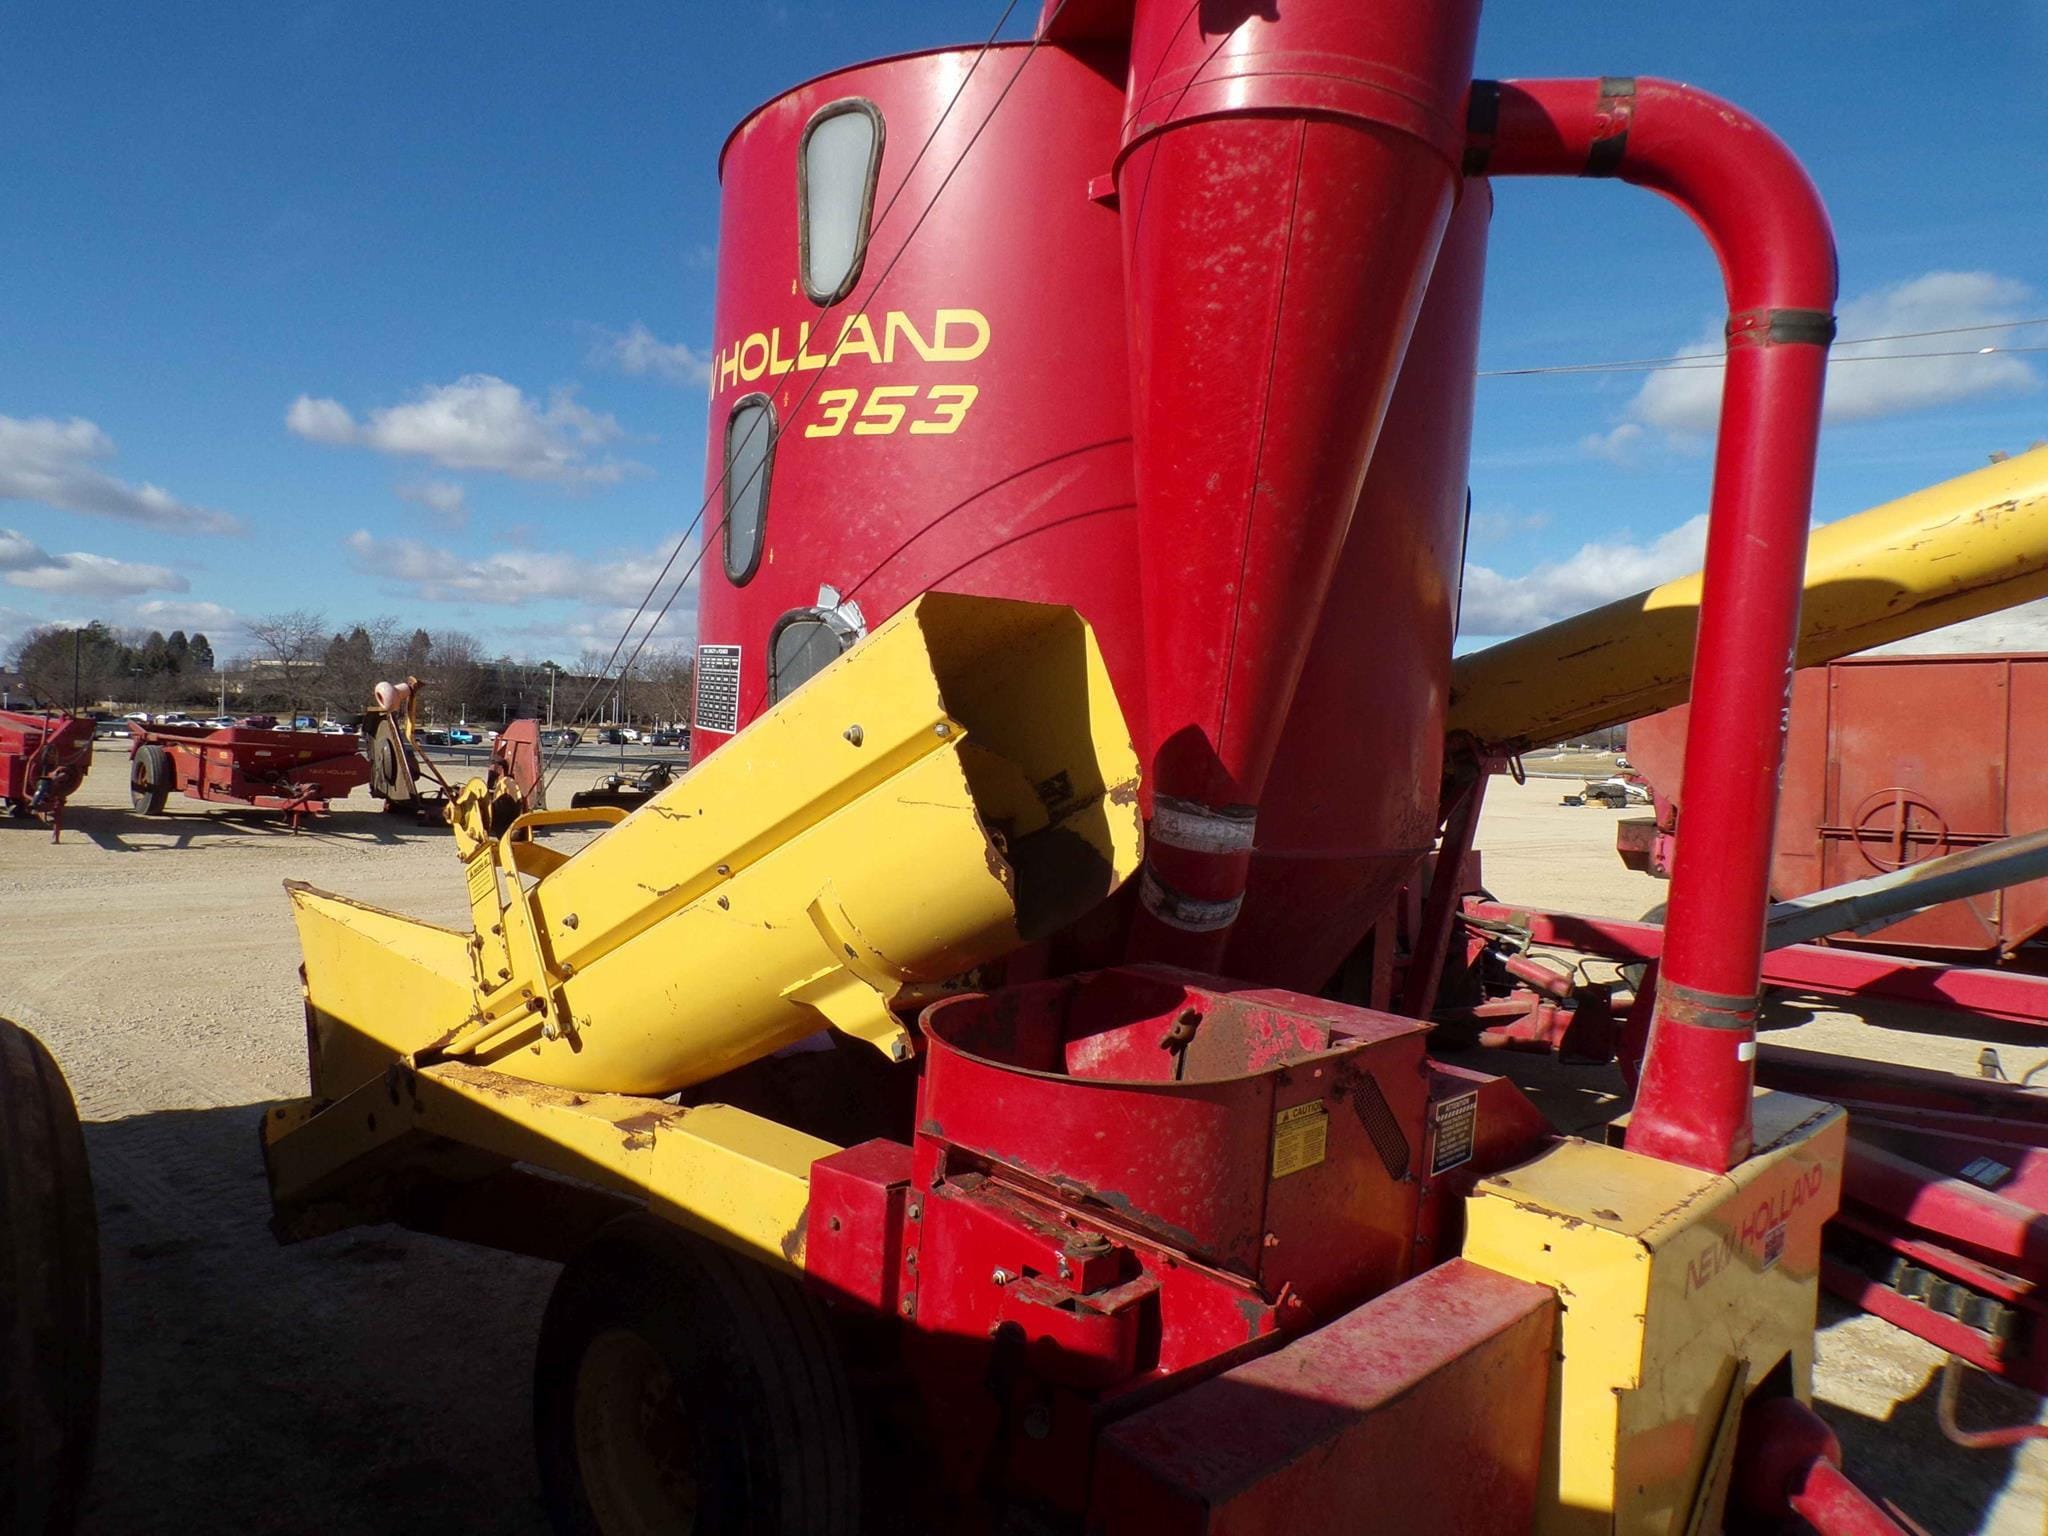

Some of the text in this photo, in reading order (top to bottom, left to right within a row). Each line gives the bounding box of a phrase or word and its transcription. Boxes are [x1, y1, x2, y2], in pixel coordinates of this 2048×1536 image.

[719, 308, 991, 394] HOLLAND
[804, 384, 980, 439] 353
[1684, 1225, 1738, 1301] NEW
[1739, 1162, 1823, 1254] HOLLAND
